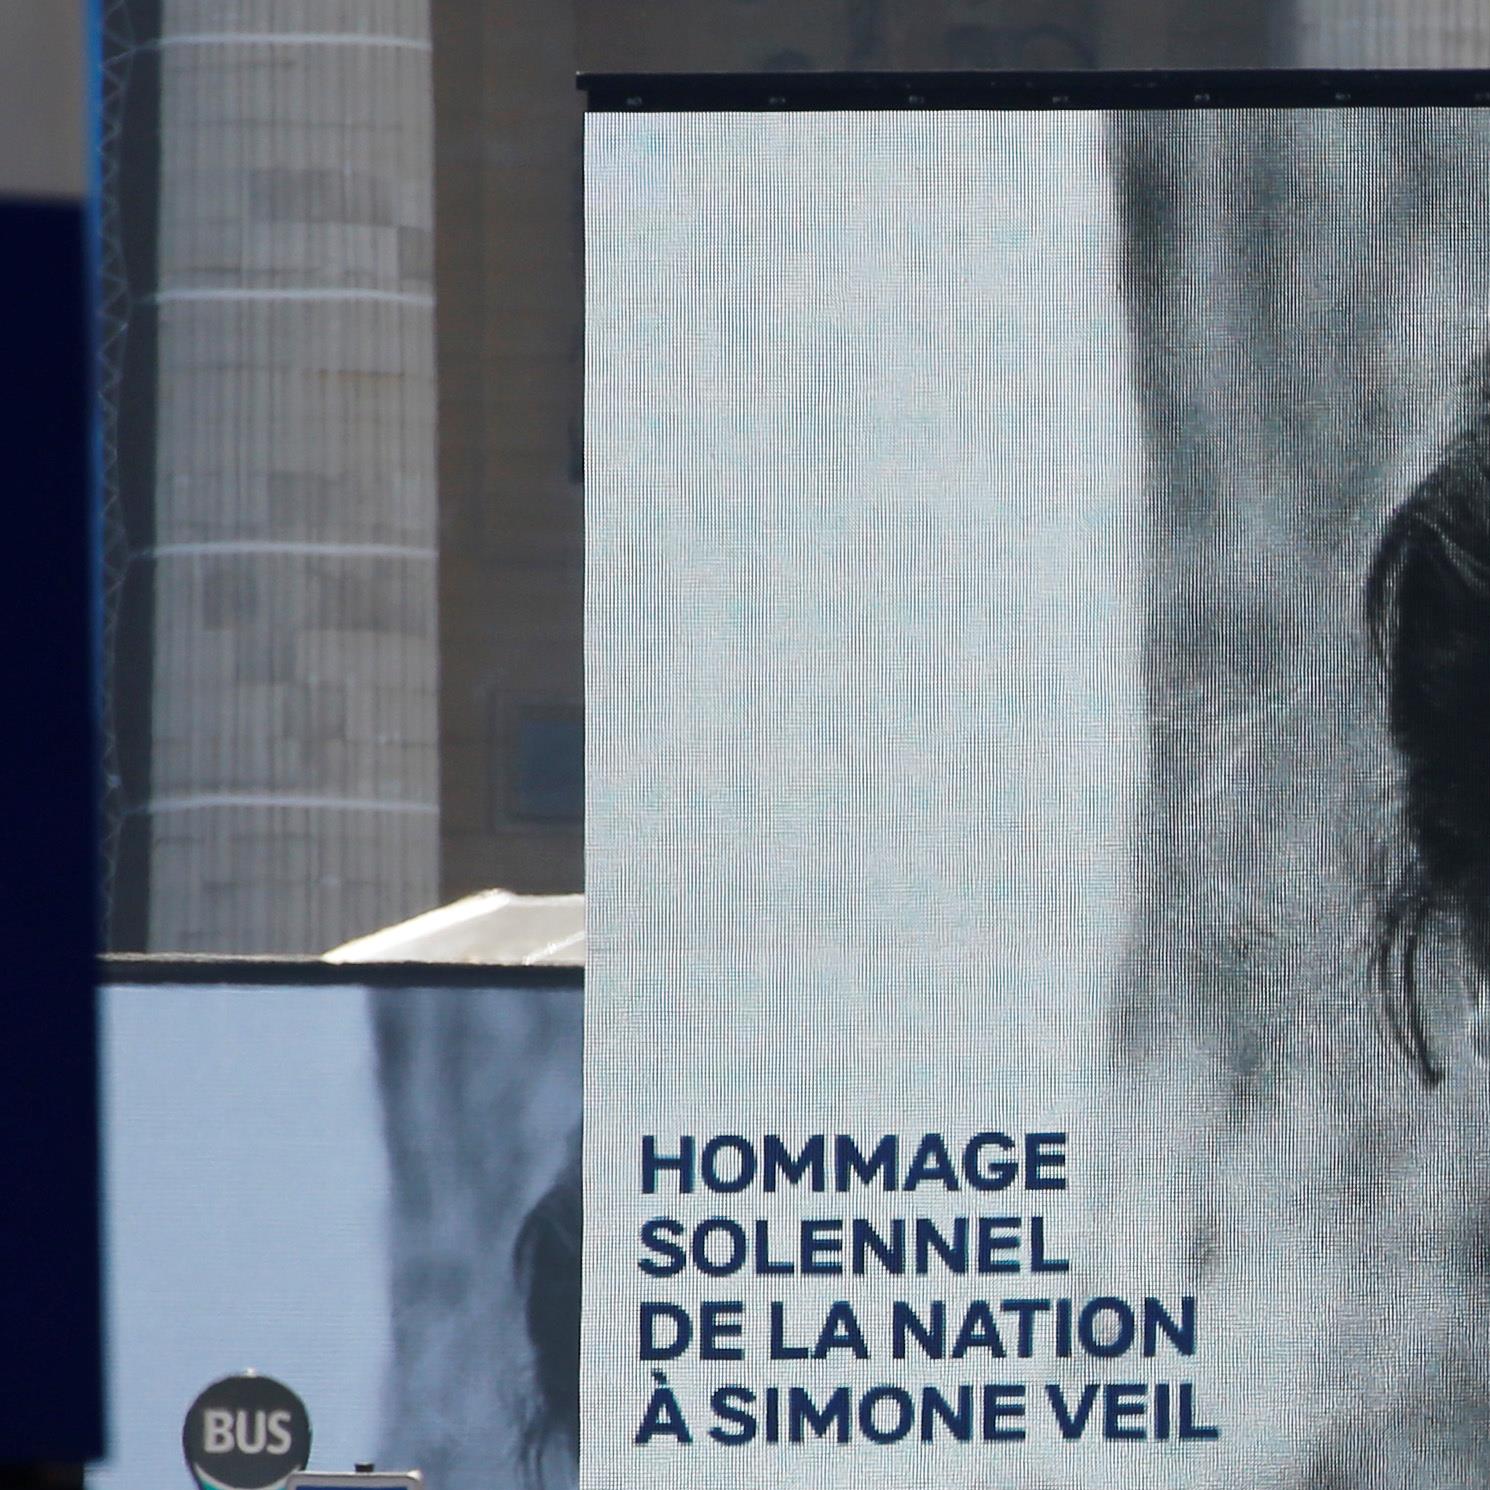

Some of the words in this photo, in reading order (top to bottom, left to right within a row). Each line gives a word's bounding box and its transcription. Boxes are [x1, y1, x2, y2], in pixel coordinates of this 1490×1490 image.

[641, 1131, 1067, 1193] HOMMAGE
[638, 1215, 1070, 1278] SOLENNEL
[638, 1299, 745, 1361] DE
[768, 1299, 869, 1360] LA
[892, 1295, 1196, 1359] NATION
[203, 1408, 292, 1455] BUS
[635, 1370, 693, 1445] À
[709, 1382, 1026, 1445] SIMONE
[1044, 1381, 1221, 1443] VEIL
